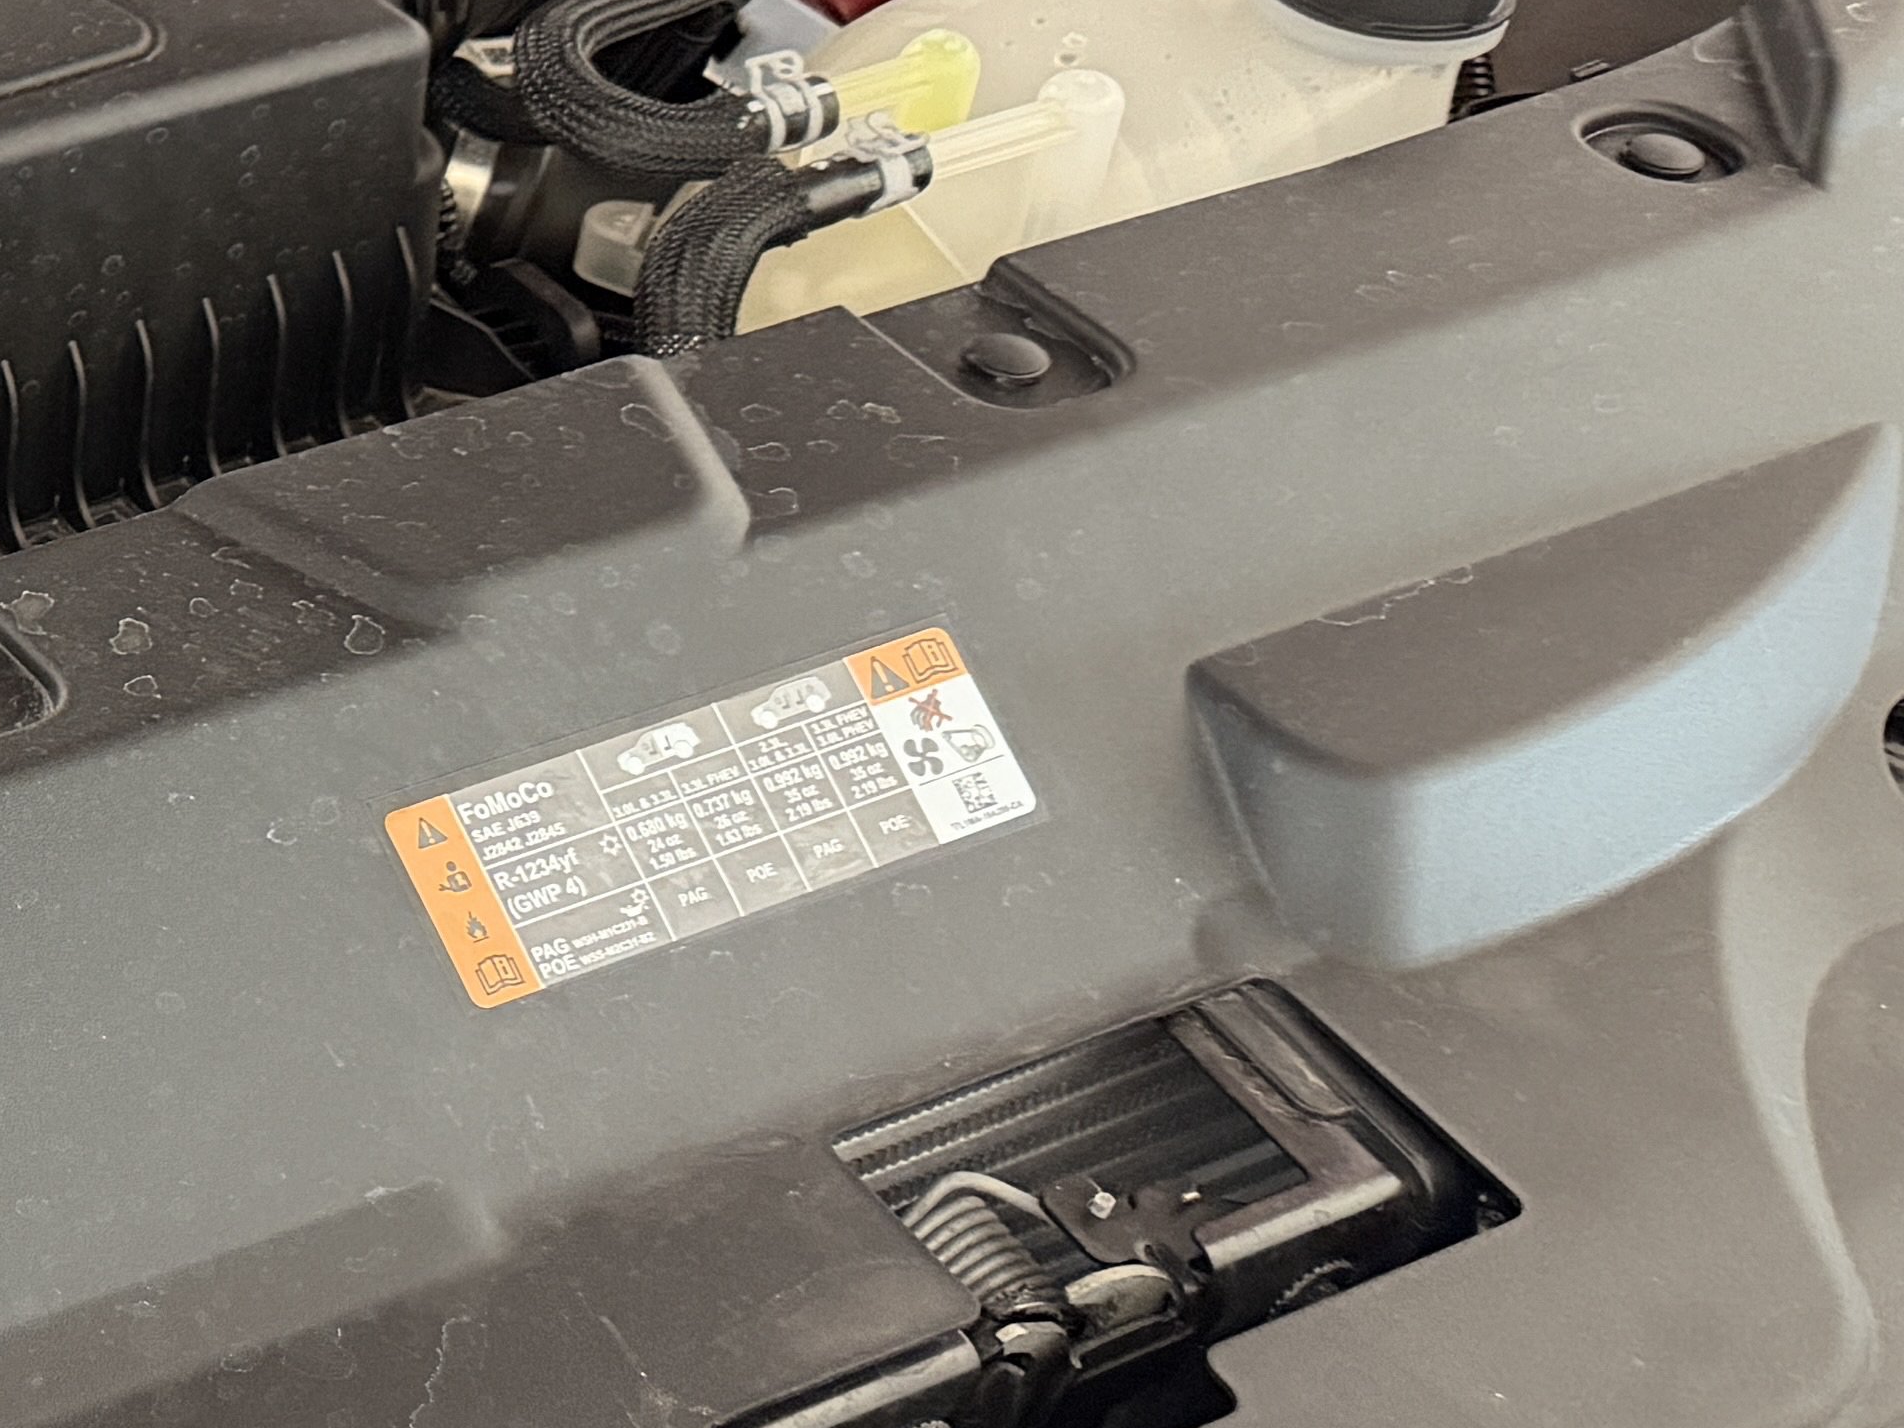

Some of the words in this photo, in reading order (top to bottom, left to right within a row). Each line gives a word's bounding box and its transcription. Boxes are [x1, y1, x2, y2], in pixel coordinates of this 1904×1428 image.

[828, 745, 869, 771] 0.992
[864, 742, 889, 758] kg
[705, 765, 741, 786] FHEV
[762, 767, 804, 793] 0.992
[799, 763, 825, 780] kg
[849, 765, 868, 781] 35
[866, 762, 885, 775] oz
[783, 787, 803, 804] 35
[801, 784, 820, 798] oz
[850, 780, 878, 800] 2.19
[875, 775, 898, 790] lbs
[456, 781, 555, 825] FoMoCo
[692, 792, 731, 818] 0.737
[730, 789, 755, 806] kg
[784, 802, 813, 822] 2.19
[810, 797, 834, 812] lbs
[471, 821, 507, 843] SAE
[506, 810, 542, 832] J639
[625, 816, 667, 842] 0.680
[663, 812, 690, 830] kg
[713, 813, 733, 830] 26
[731, 810, 753, 824] oz
[878, 814, 911, 835] POE
[525, 821, 568, 846] J2845
[646, 837, 666, 853] 24
[665, 833, 684, 847] oz
[715, 828, 743, 847] 1.63
[740, 823, 763, 838] lbs
[648, 851, 676, 871] 1.50
[674, 847, 698, 862] lbs
[812, 838, 845, 859] PAG
[493, 846, 581, 891] R-1234yf
[745, 862, 779, 883] POE
[507, 883, 562, 920] (GWP
[565, 875, 588, 897] 4)
[677, 886, 713, 907] PAG
[530, 937, 571, 963] PAG
[538, 953, 581, 979] POE
